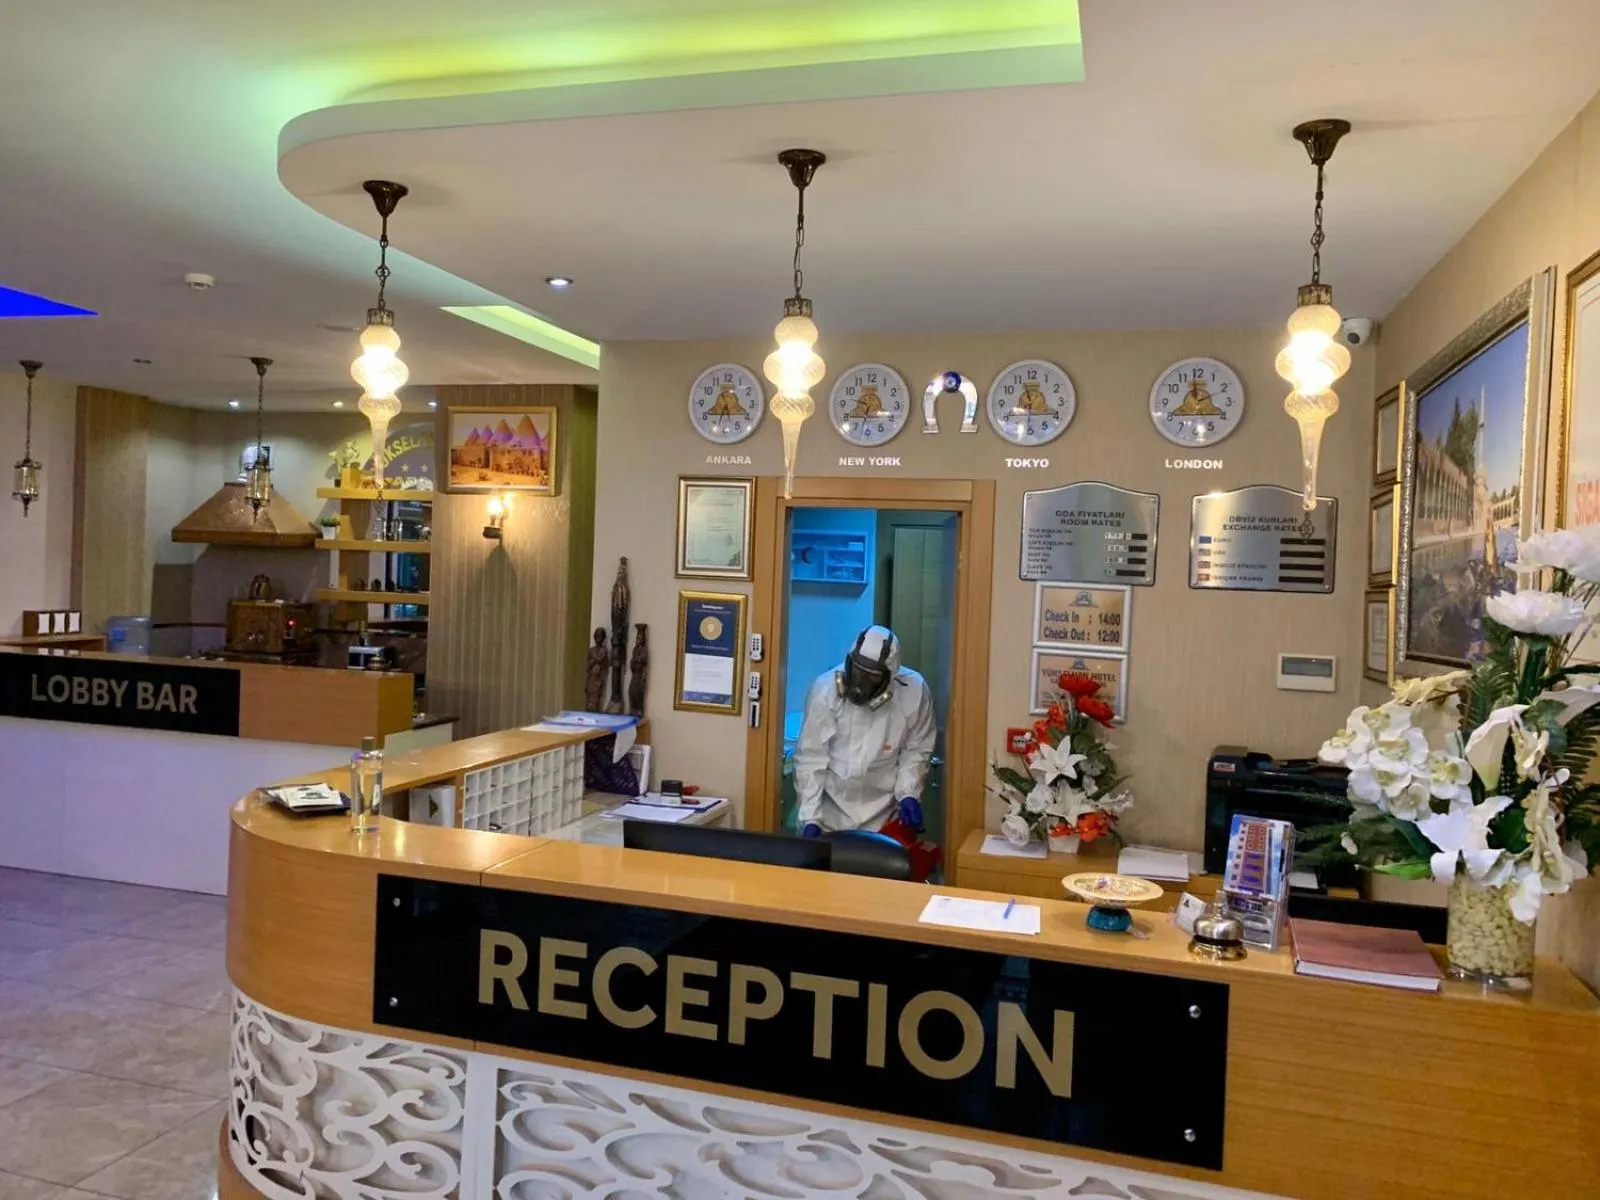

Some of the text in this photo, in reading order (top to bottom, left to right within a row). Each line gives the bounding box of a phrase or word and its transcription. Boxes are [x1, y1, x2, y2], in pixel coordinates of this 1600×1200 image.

[724, 374, 733, 382] 12
[1027, 370, 1037, 380] 12
[1178, 373, 1187, 383] 11
[1192, 369, 1203, 378] 12
[712, 377, 720, 386] 11
[855, 376, 863, 386] 11
[867, 374, 877, 383] 12
[1014, 375, 1022, 384] 11
[704, 386, 713, 395] 10
[845, 387, 855, 396] 10
[1003, 386, 1014, 395] 10
[1168, 384, 1179, 393] 10
[706, 455, 752, 465] ANKARA
[839, 457, 901, 466] NEW YORK
[1005, 458, 1050, 468] TOKYO
[1165, 459, 1223, 469] LONDON
[1091, 519, 1122, 527] RATES
[1223, 524, 1272, 532] EXCHANGE
[1045, 609, 1069, 622] Check
[1072, 611, 1080, 623] In
[1099, 612, 1121, 626] 14:00
[1043, 627, 1068, 640] Check
[1071, 628, 1085, 640] Out
[1098, 630, 1120, 643] 12:00
[31, 673, 198, 714] LOBBY BAR
[479, 928, 1074, 1099] RECEPTION
